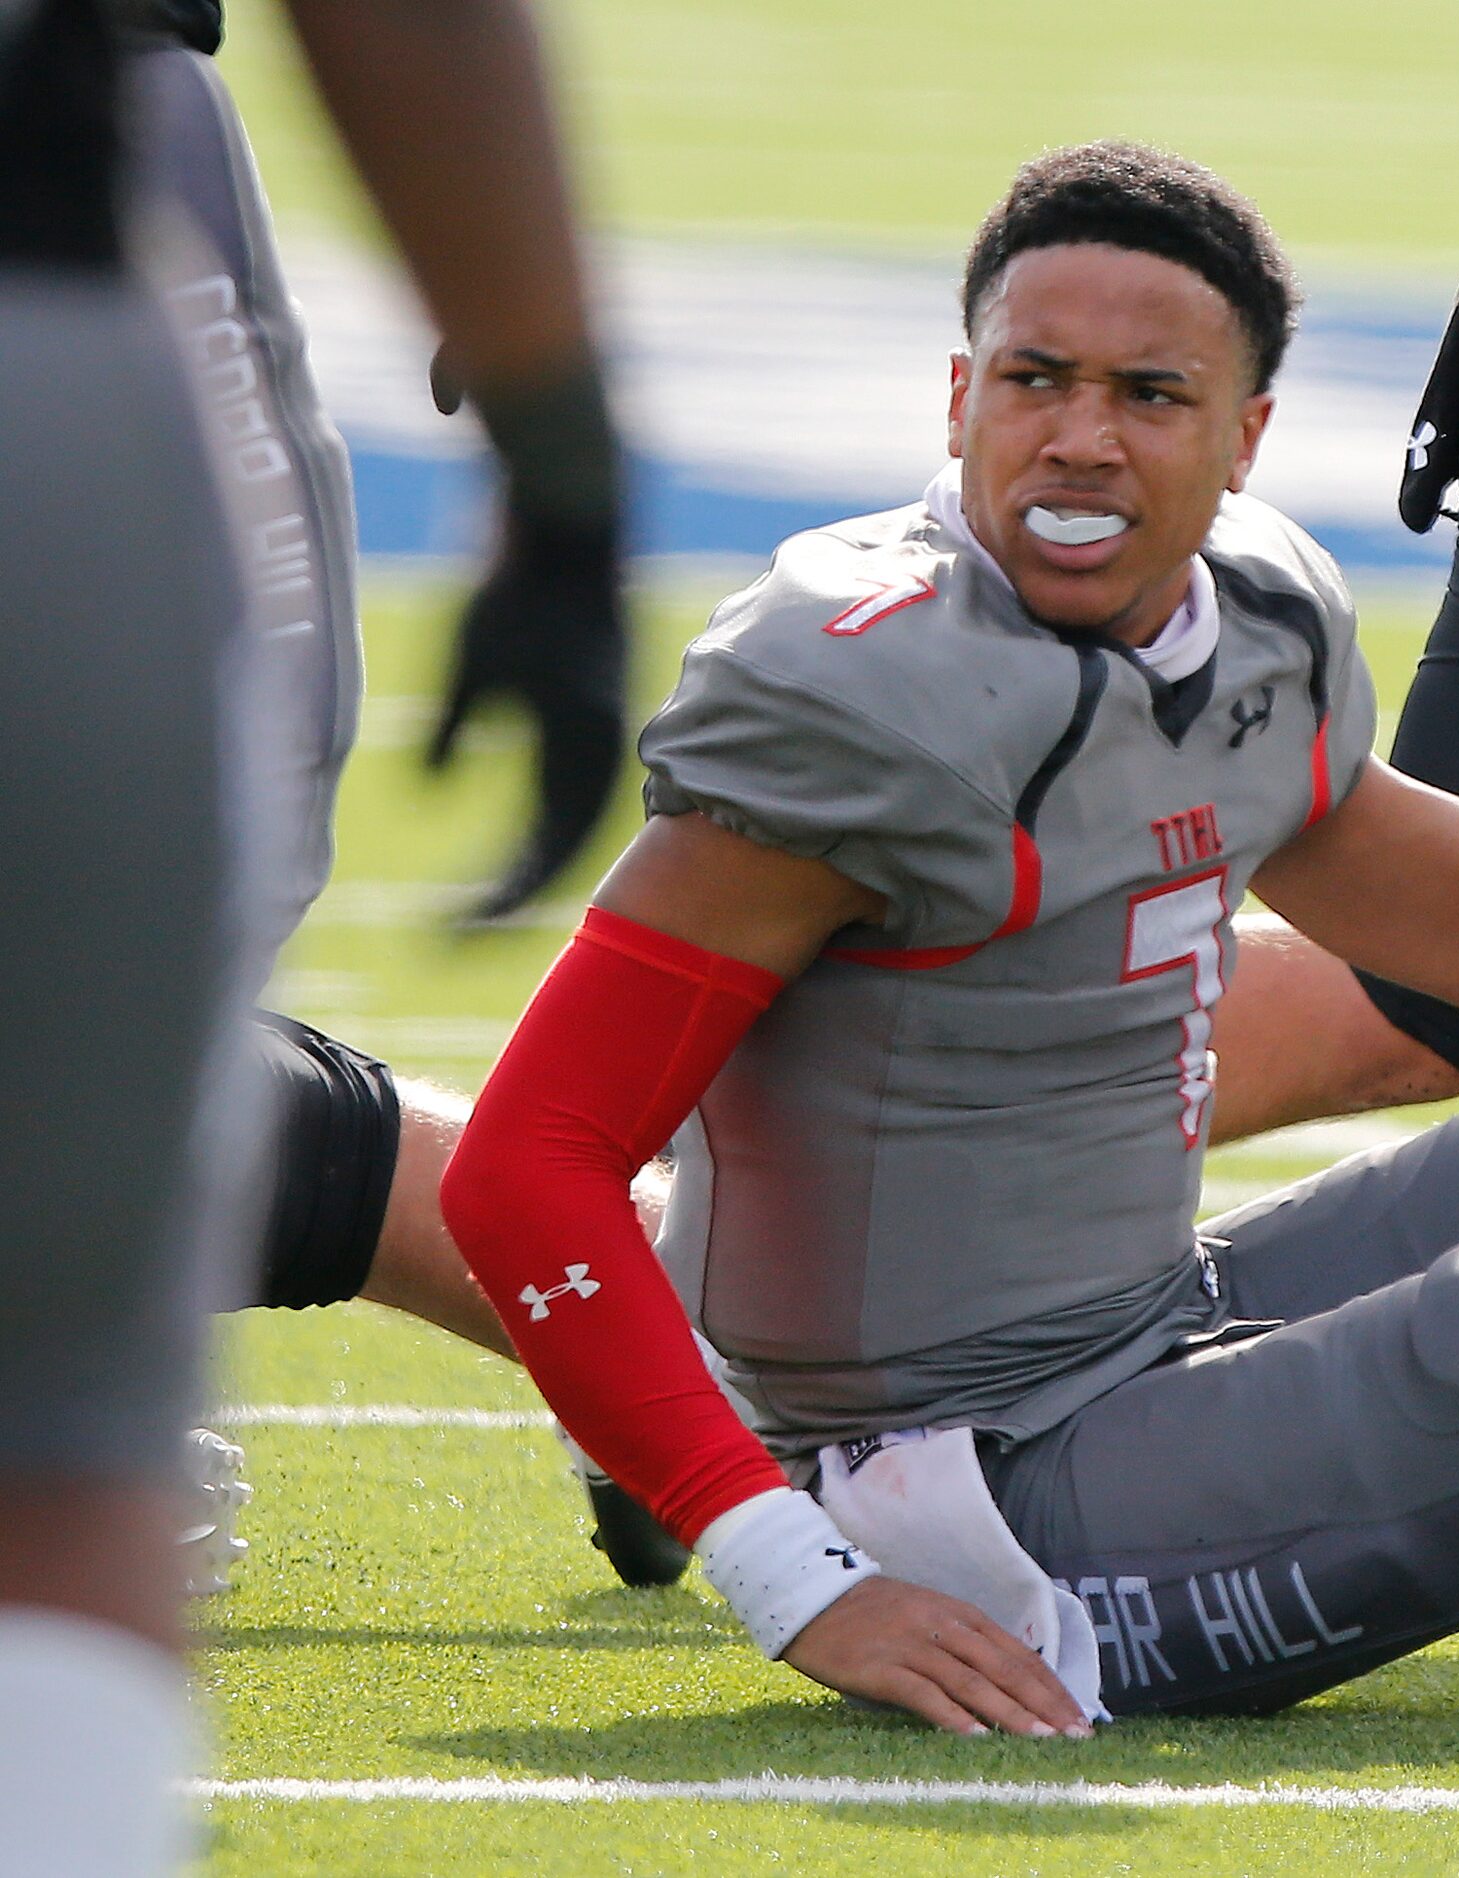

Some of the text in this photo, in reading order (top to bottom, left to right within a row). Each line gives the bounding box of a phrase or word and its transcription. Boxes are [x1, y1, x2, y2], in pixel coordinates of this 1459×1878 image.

[821, 573, 938, 637] 7
[1120, 865, 1228, 1151] 7
[1053, 1560, 1363, 1689] AR HILL
